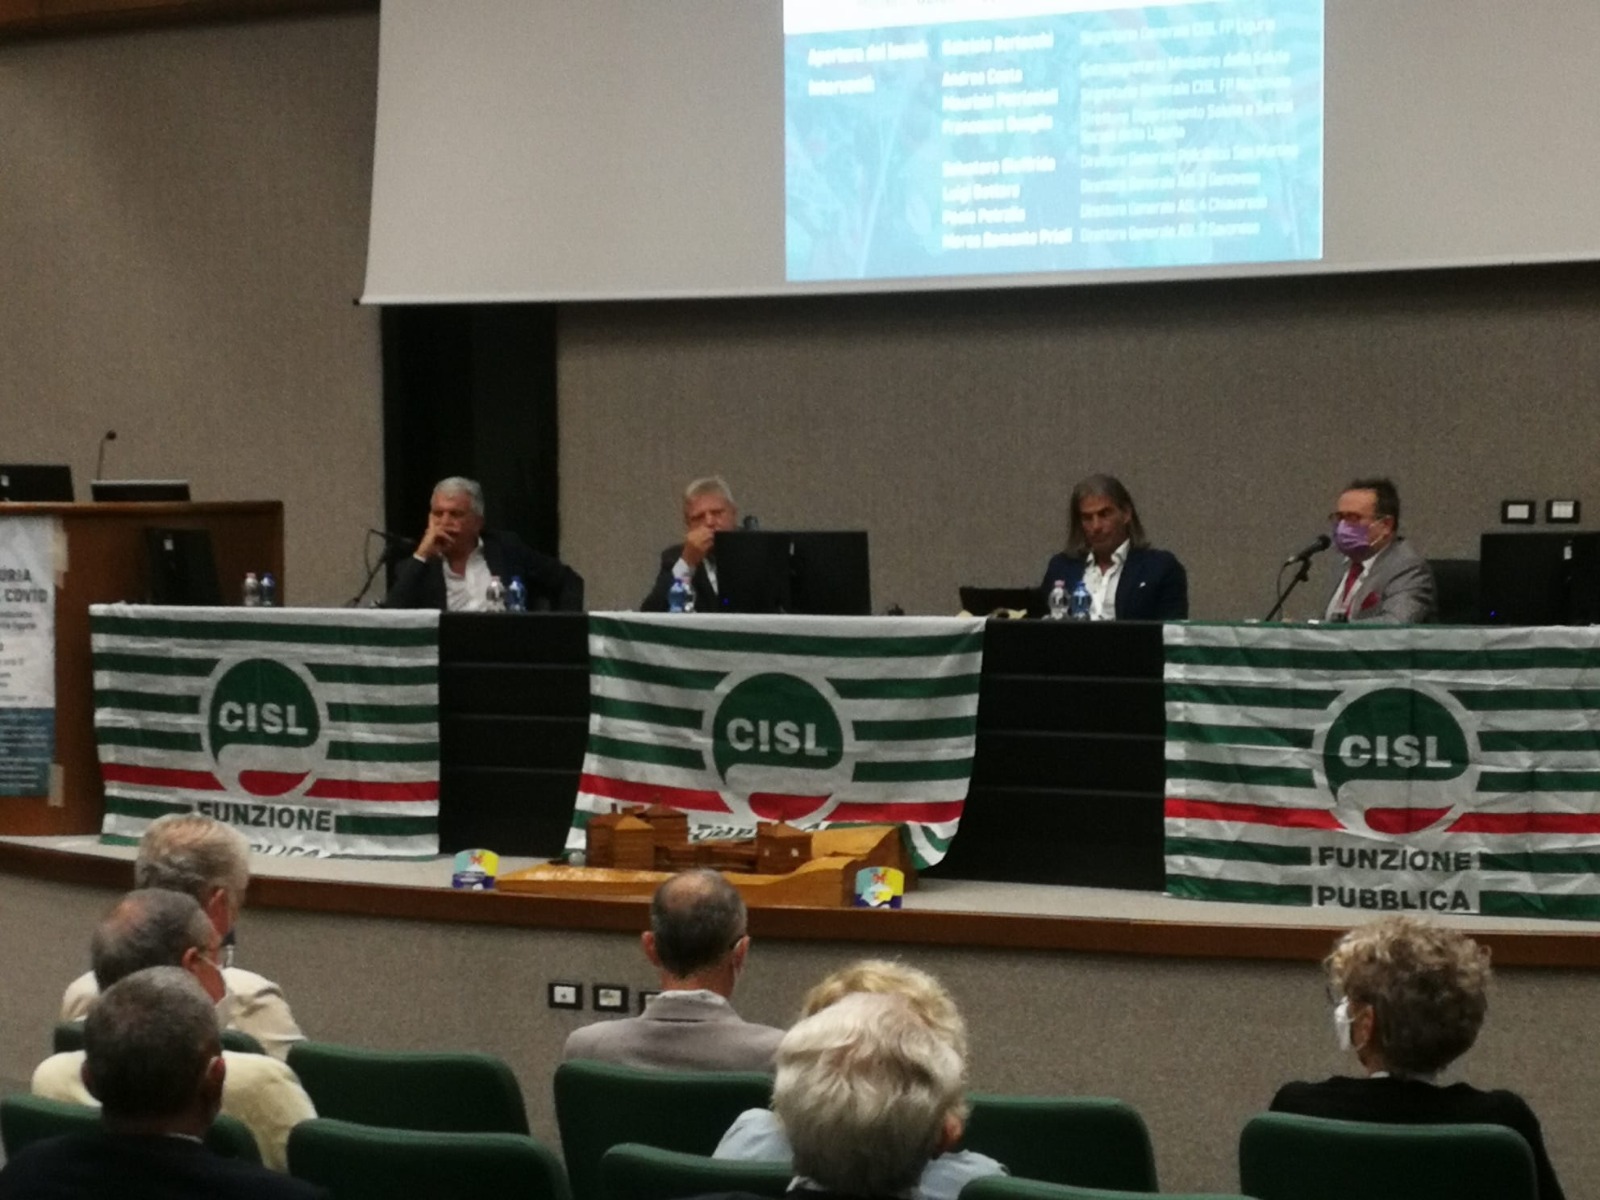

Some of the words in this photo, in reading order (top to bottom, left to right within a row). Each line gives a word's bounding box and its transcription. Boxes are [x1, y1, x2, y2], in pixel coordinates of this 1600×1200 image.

[218, 701, 309, 736] CISL
[725, 717, 828, 757] CISL
[1338, 734, 1453, 768] CISL
[197, 800, 332, 832] FUNZIONE
[1318, 846, 1472, 872] FUNZIONE
[1317, 885, 1472, 912] PUBBLICA
